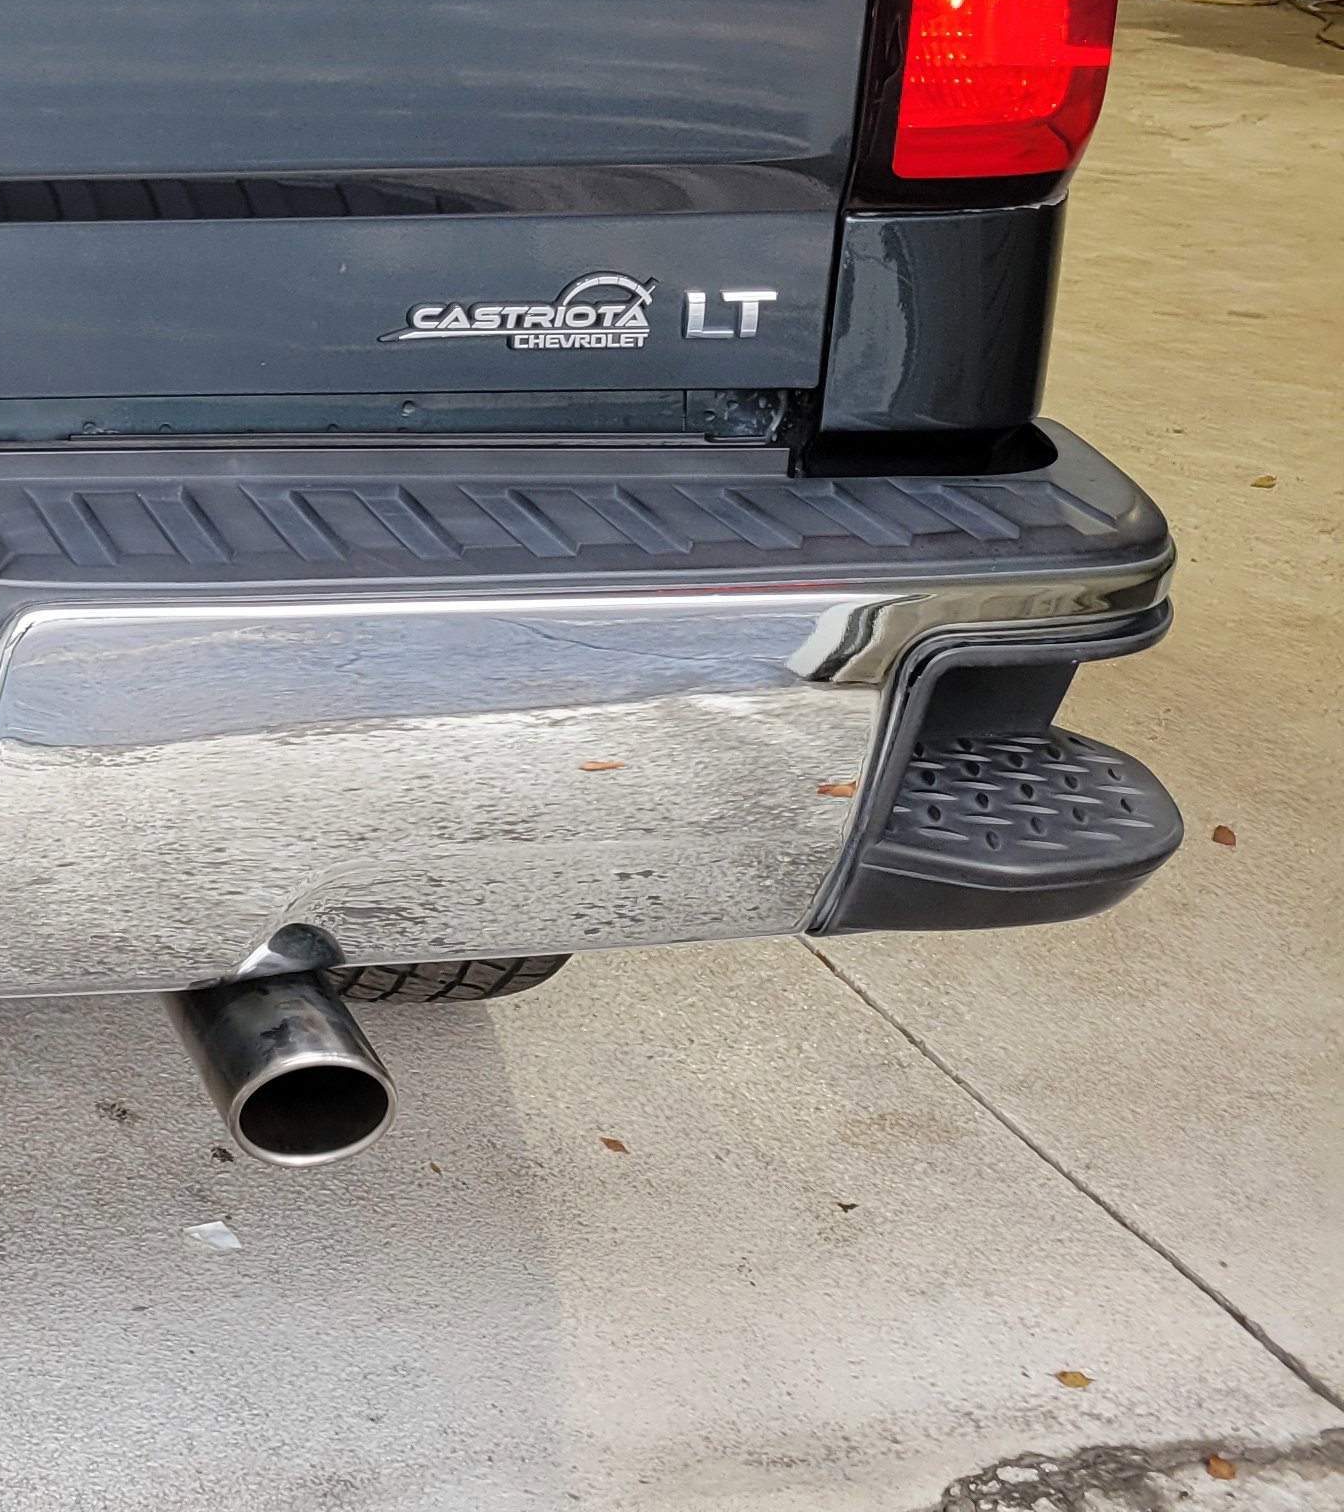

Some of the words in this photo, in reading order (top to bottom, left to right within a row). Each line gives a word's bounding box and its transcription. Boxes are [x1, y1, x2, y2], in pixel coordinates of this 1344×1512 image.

[413, 304, 649, 329] CASTRIOTA
[685, 291, 779, 339] LT
[513, 333, 649, 349] CHEVROLET
